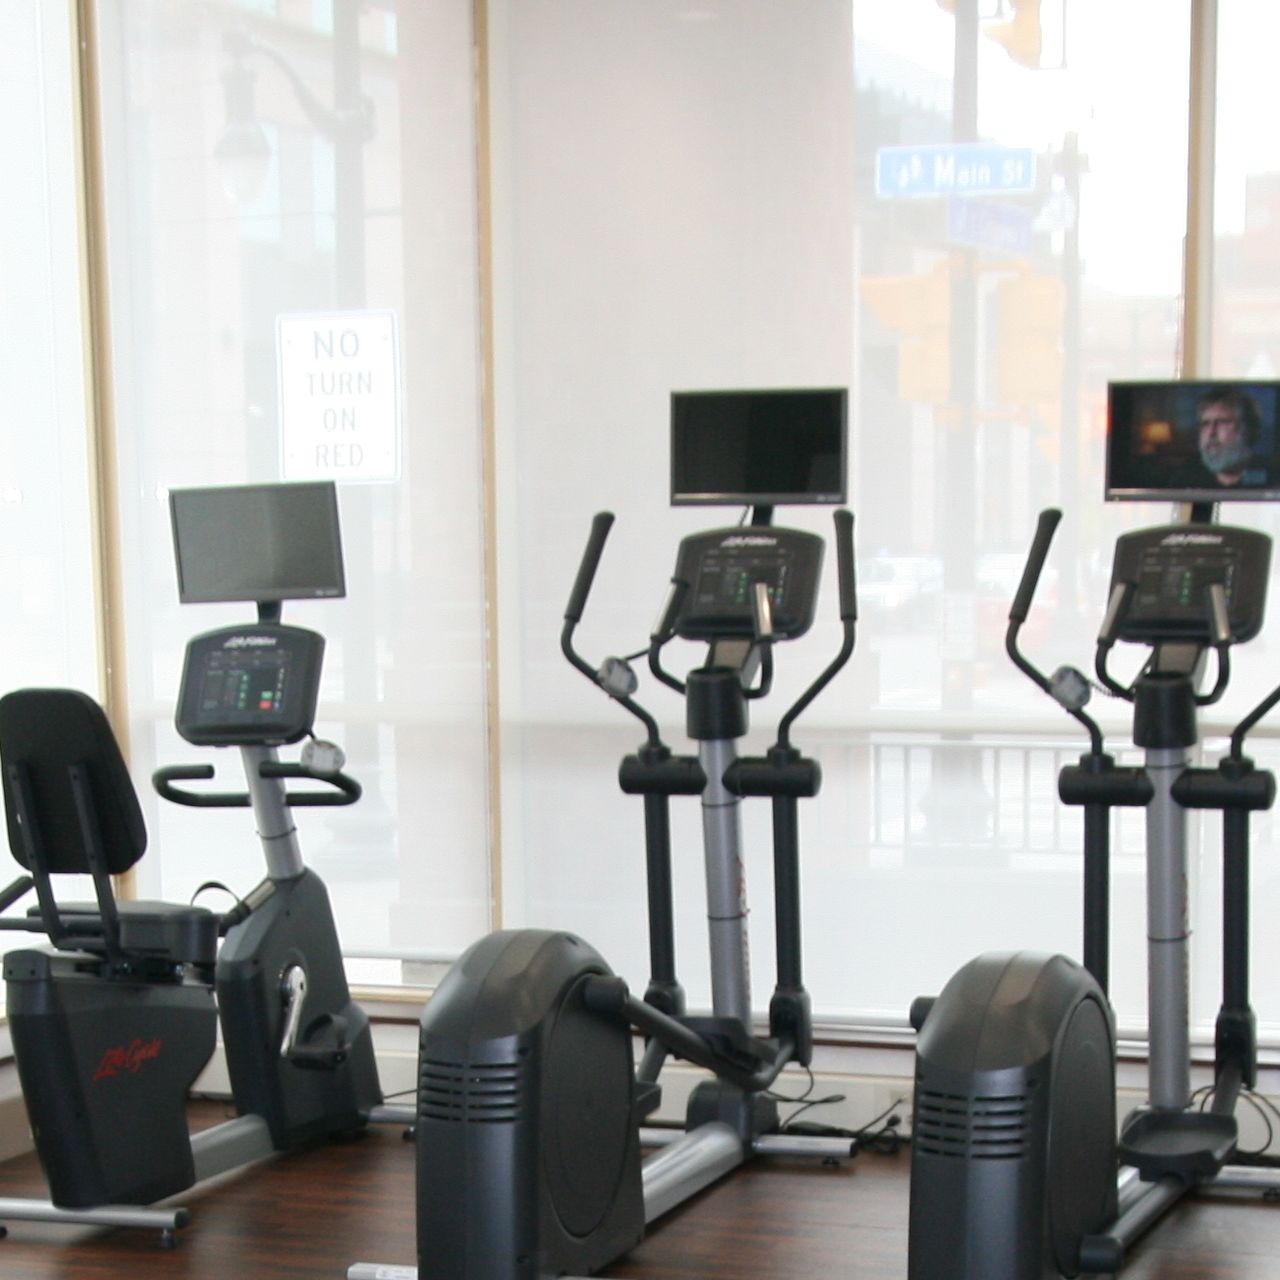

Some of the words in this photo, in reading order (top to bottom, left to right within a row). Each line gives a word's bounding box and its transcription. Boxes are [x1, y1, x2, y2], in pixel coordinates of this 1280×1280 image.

[933, 153, 992, 187] Main
[313, 328, 360, 361] NO
[307, 371, 373, 396] TURN
[323, 407, 356, 433] ON
[315, 443, 364, 468] RED
